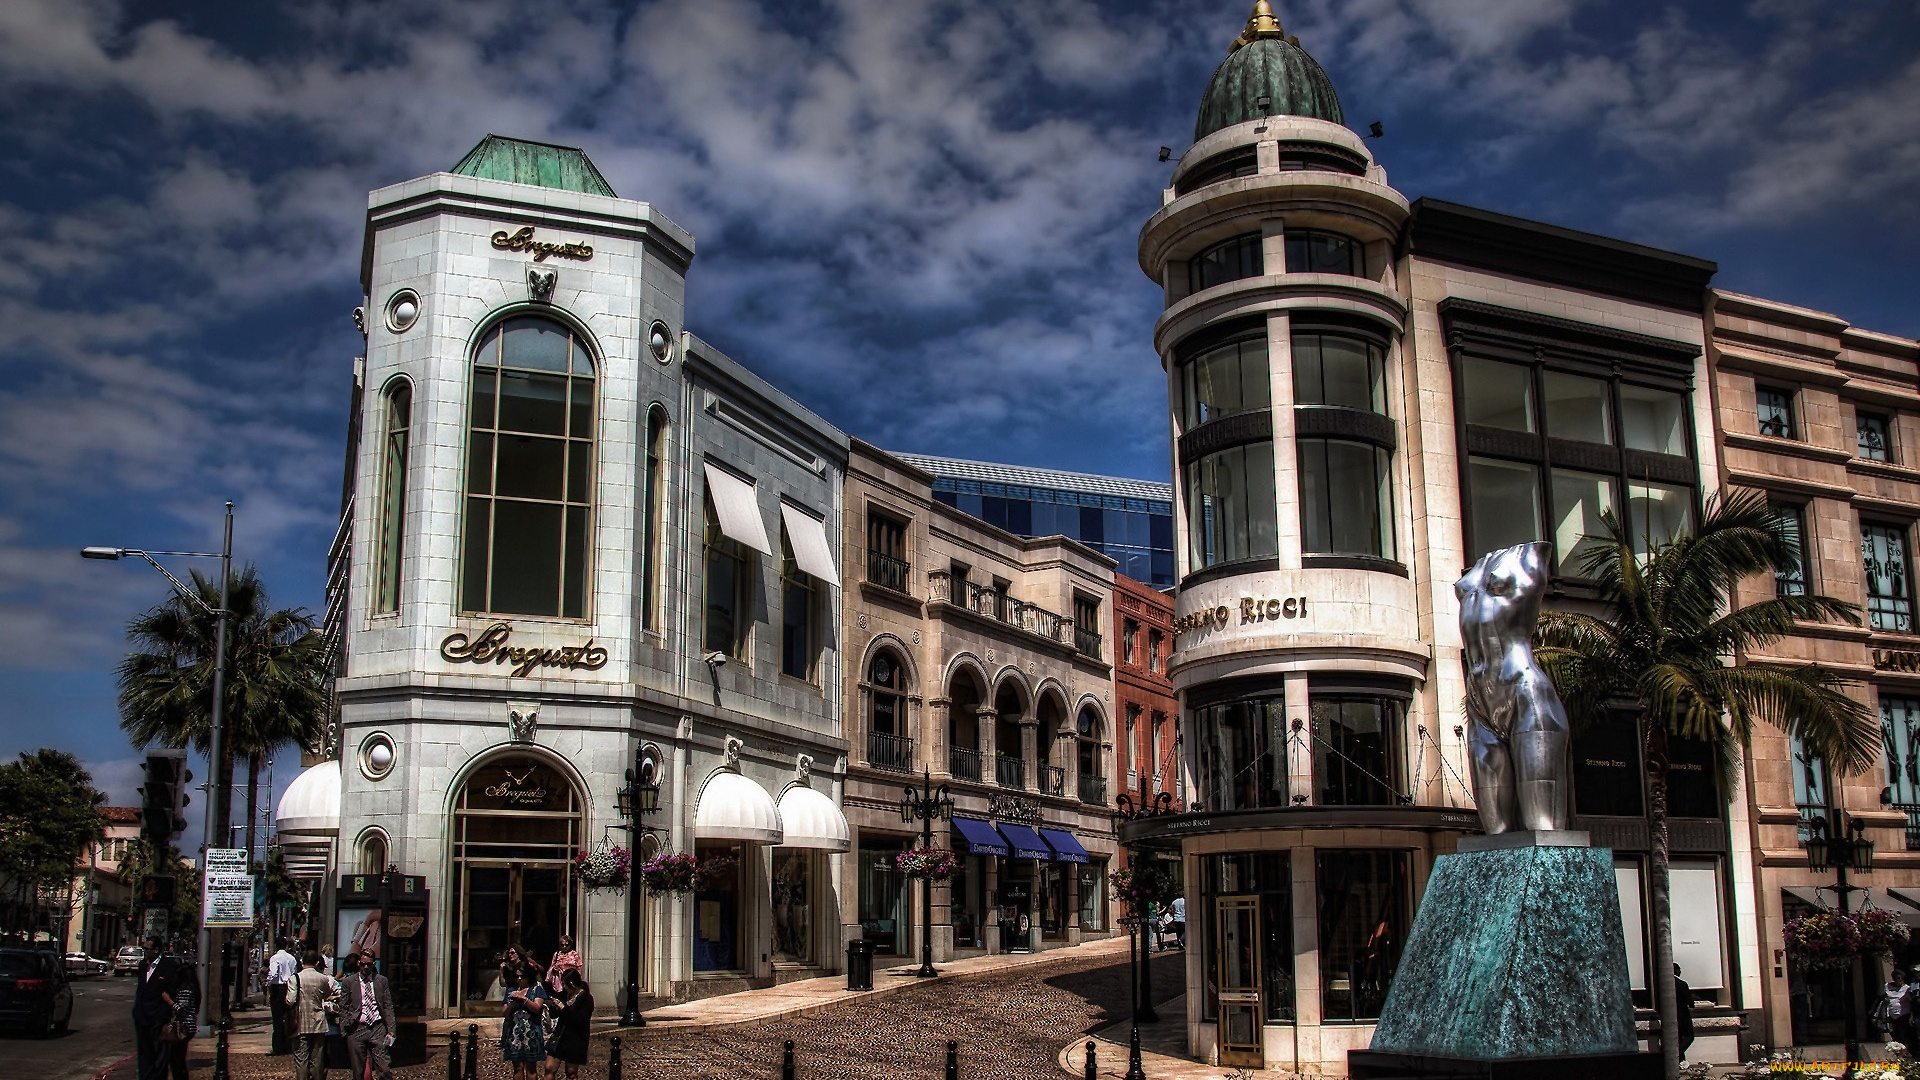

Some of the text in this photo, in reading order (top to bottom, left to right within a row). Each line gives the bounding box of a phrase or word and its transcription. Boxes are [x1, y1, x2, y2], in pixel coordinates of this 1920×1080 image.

[491, 226, 594, 262] Breguet
[1240, 597, 1307, 624] RICCI
[441, 622, 608, 678] Breguet
[485, 781, 547, 804] Breguet
